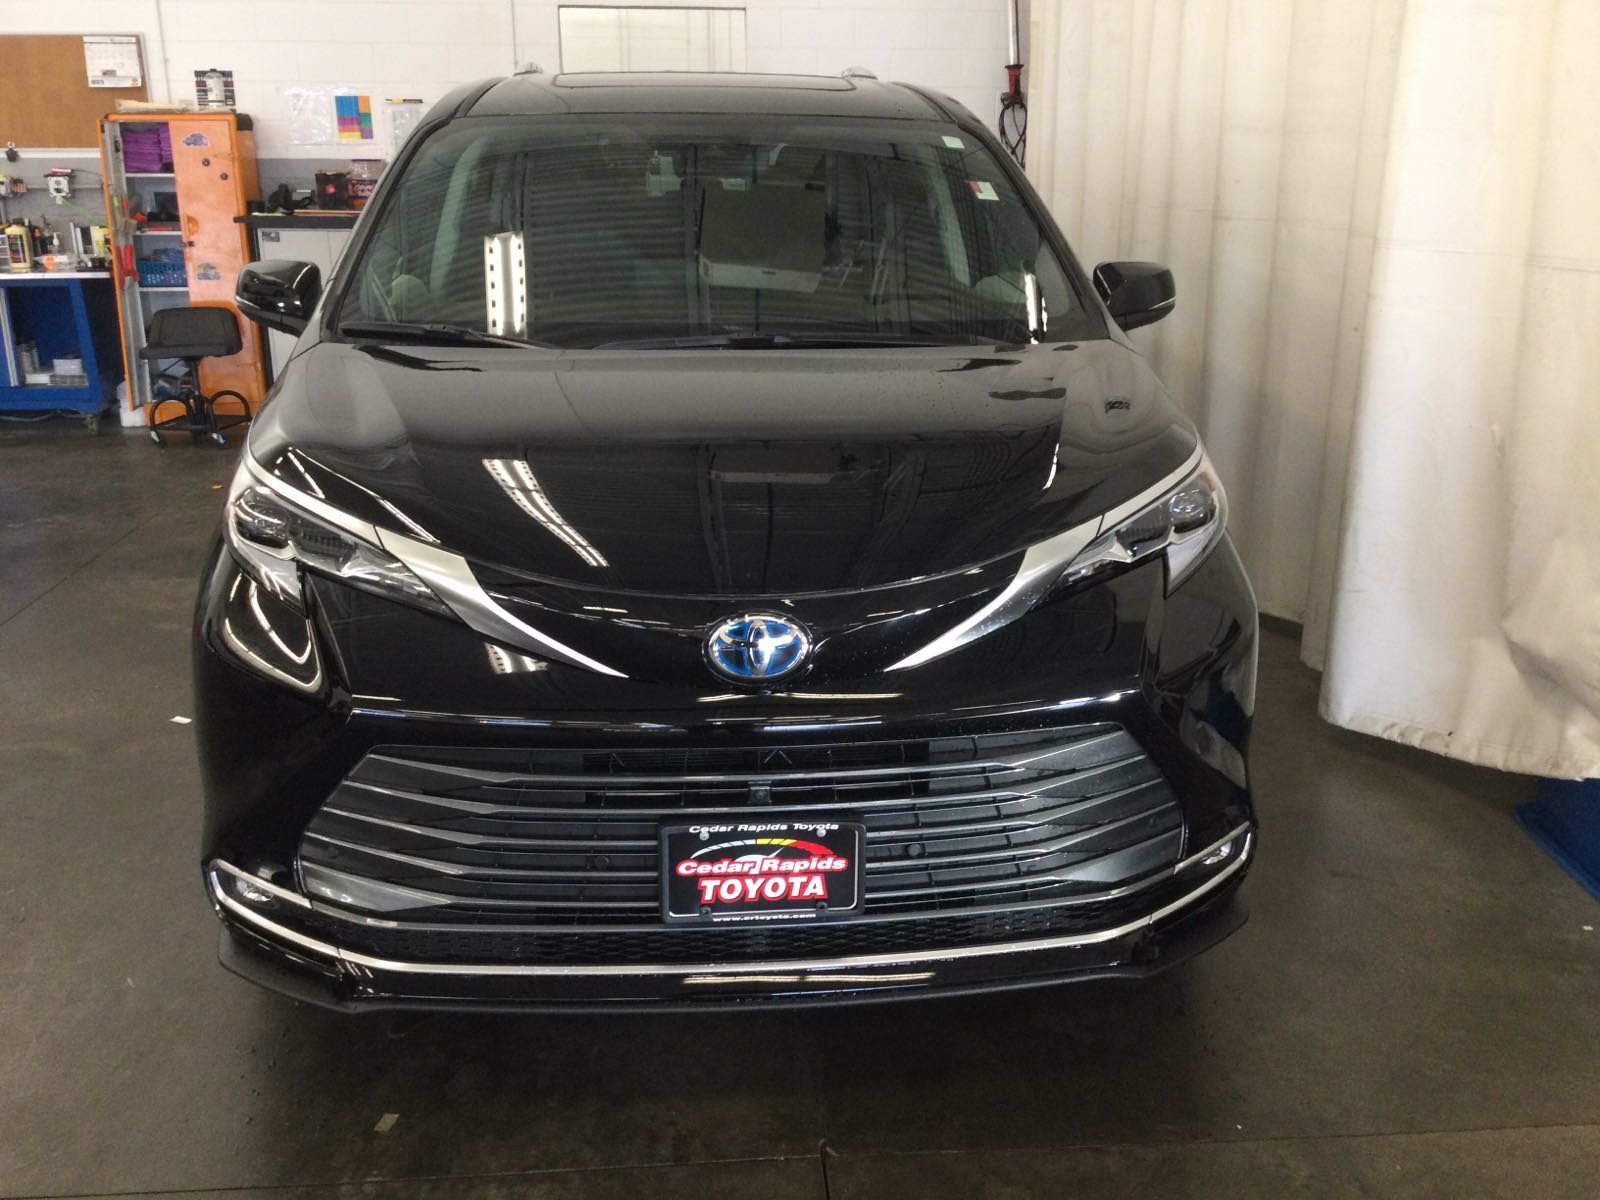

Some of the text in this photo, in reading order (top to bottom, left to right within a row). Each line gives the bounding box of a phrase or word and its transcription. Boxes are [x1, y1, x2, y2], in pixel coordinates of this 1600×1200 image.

[688, 822, 839, 833] Cedar Rapids Toyota
[678, 857, 847, 875] Cedar Rapids
[700, 876, 825, 901] TOYOTA
